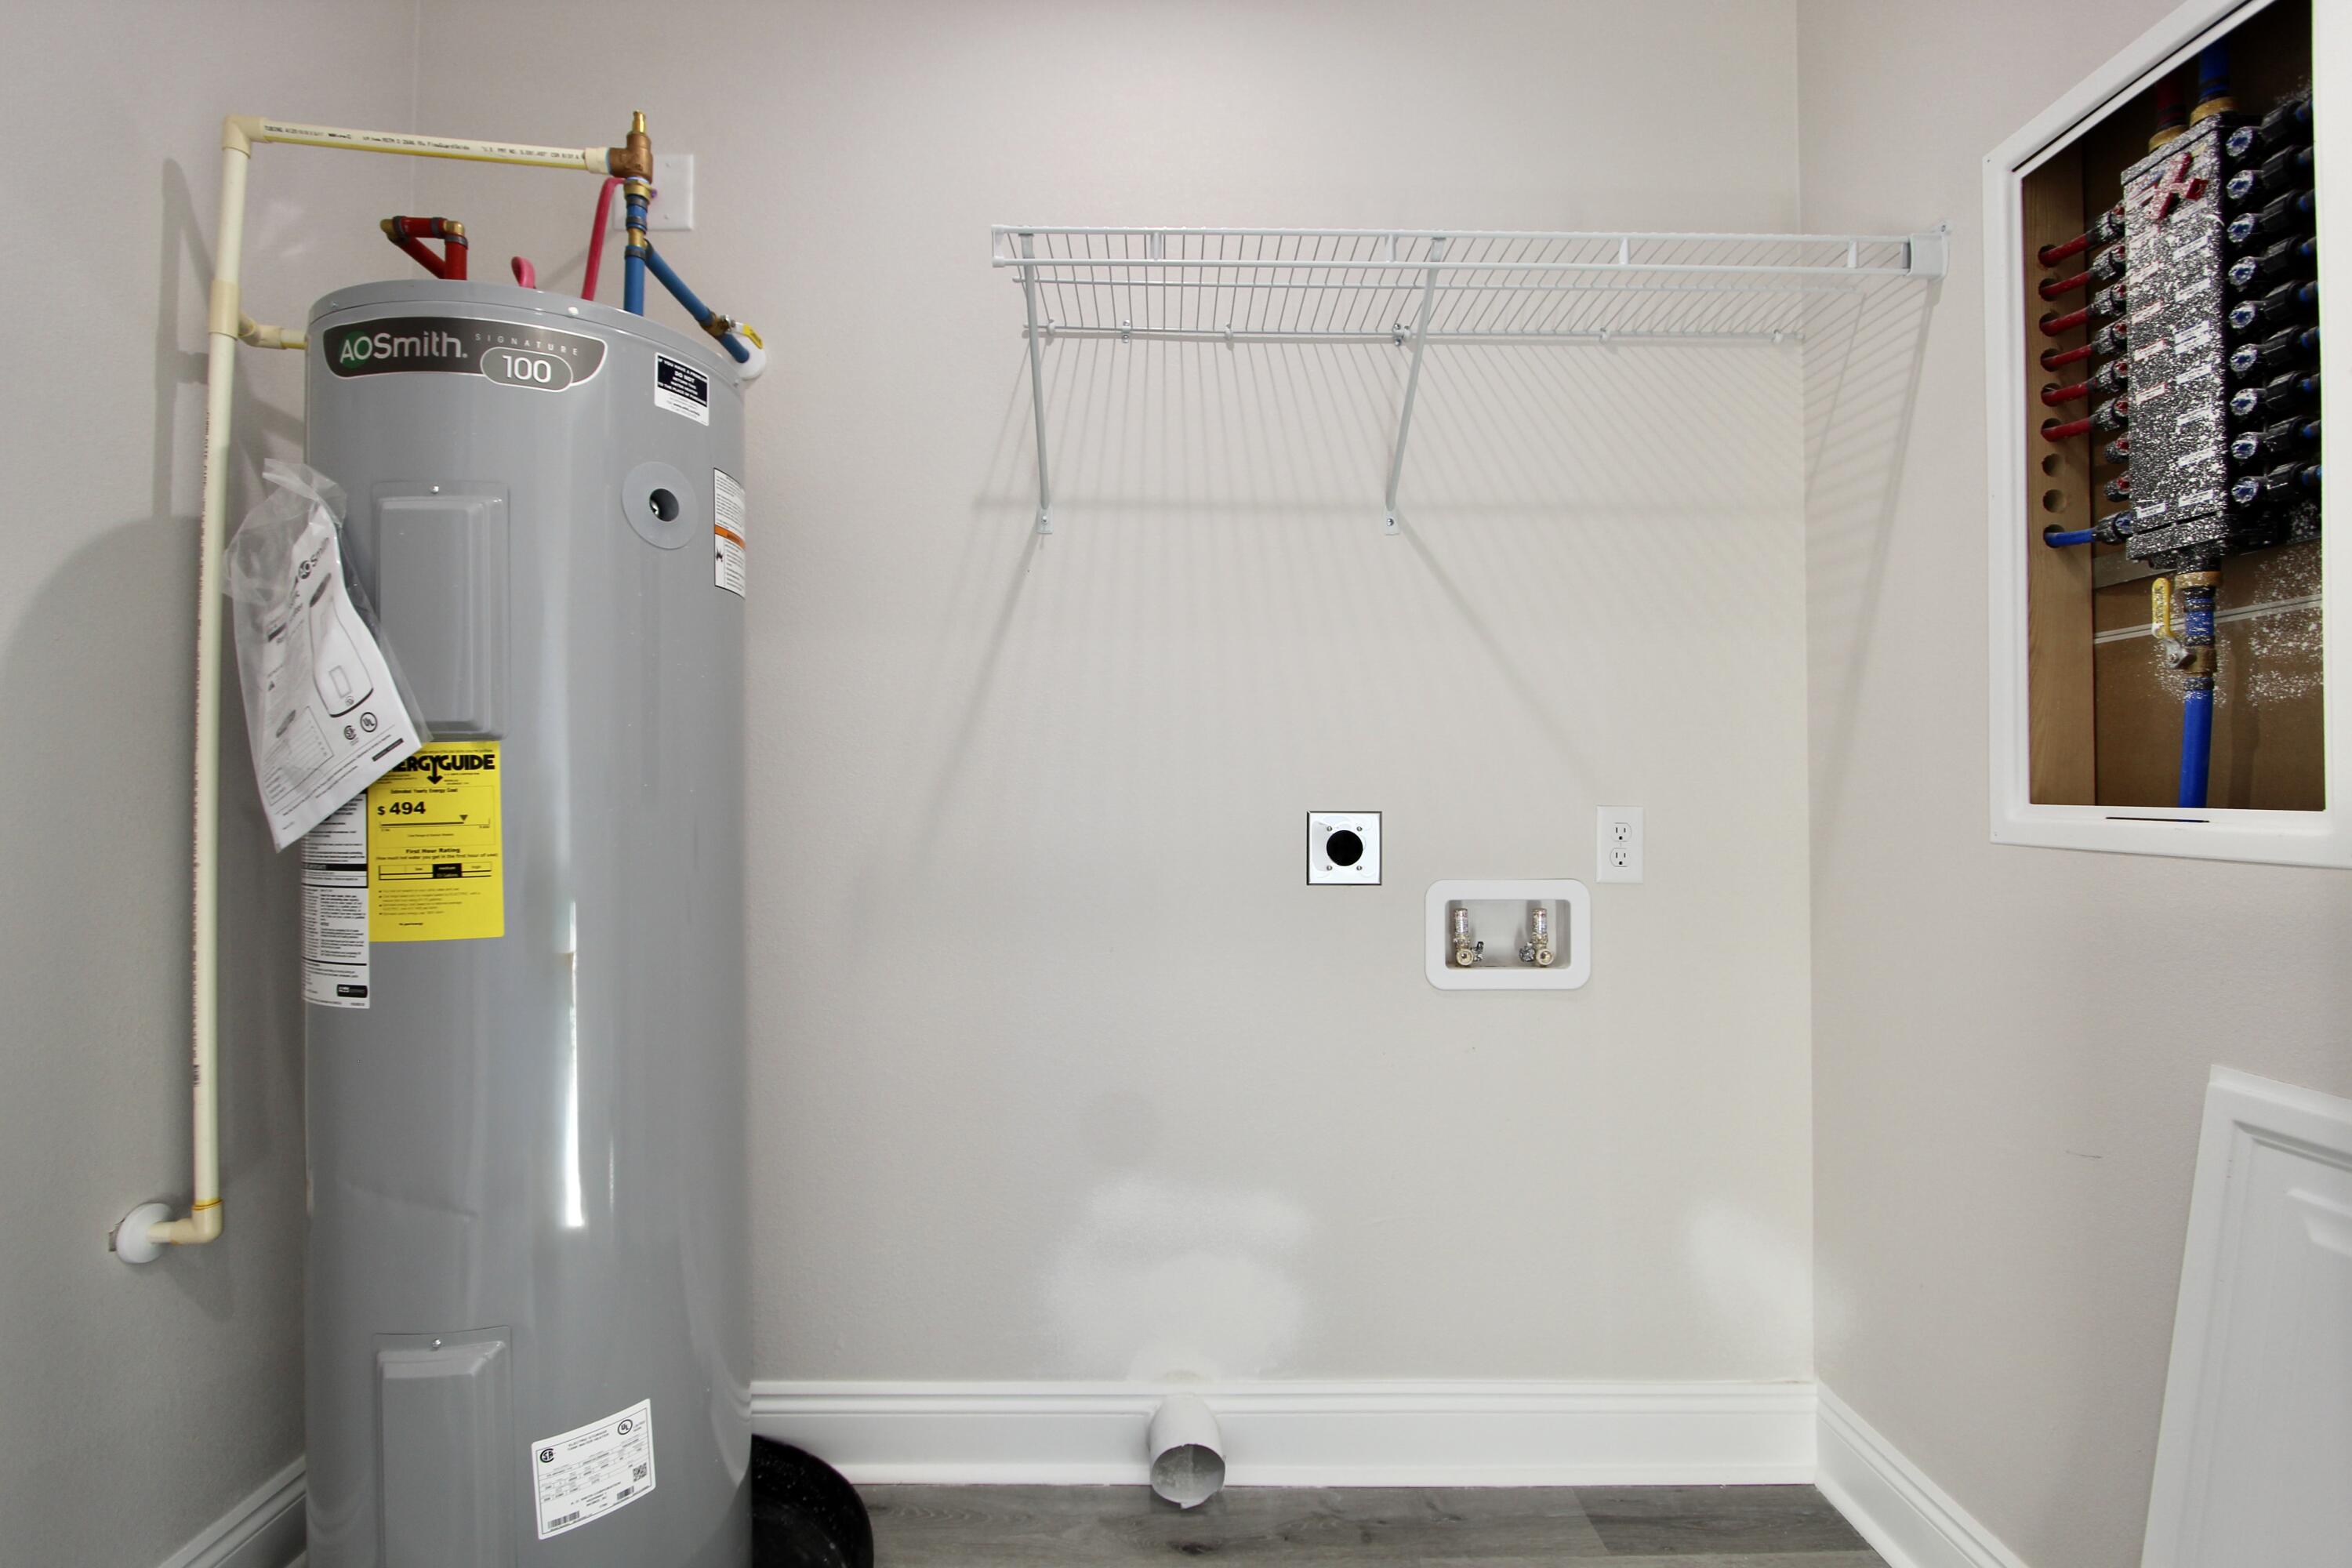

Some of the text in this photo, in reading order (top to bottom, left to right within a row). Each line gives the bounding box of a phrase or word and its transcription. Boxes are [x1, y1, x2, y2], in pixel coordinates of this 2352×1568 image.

[475, 332, 579, 356] SIGNATURE
[502, 354, 551, 383] 100
[377, 801, 426, 815] $ 494
